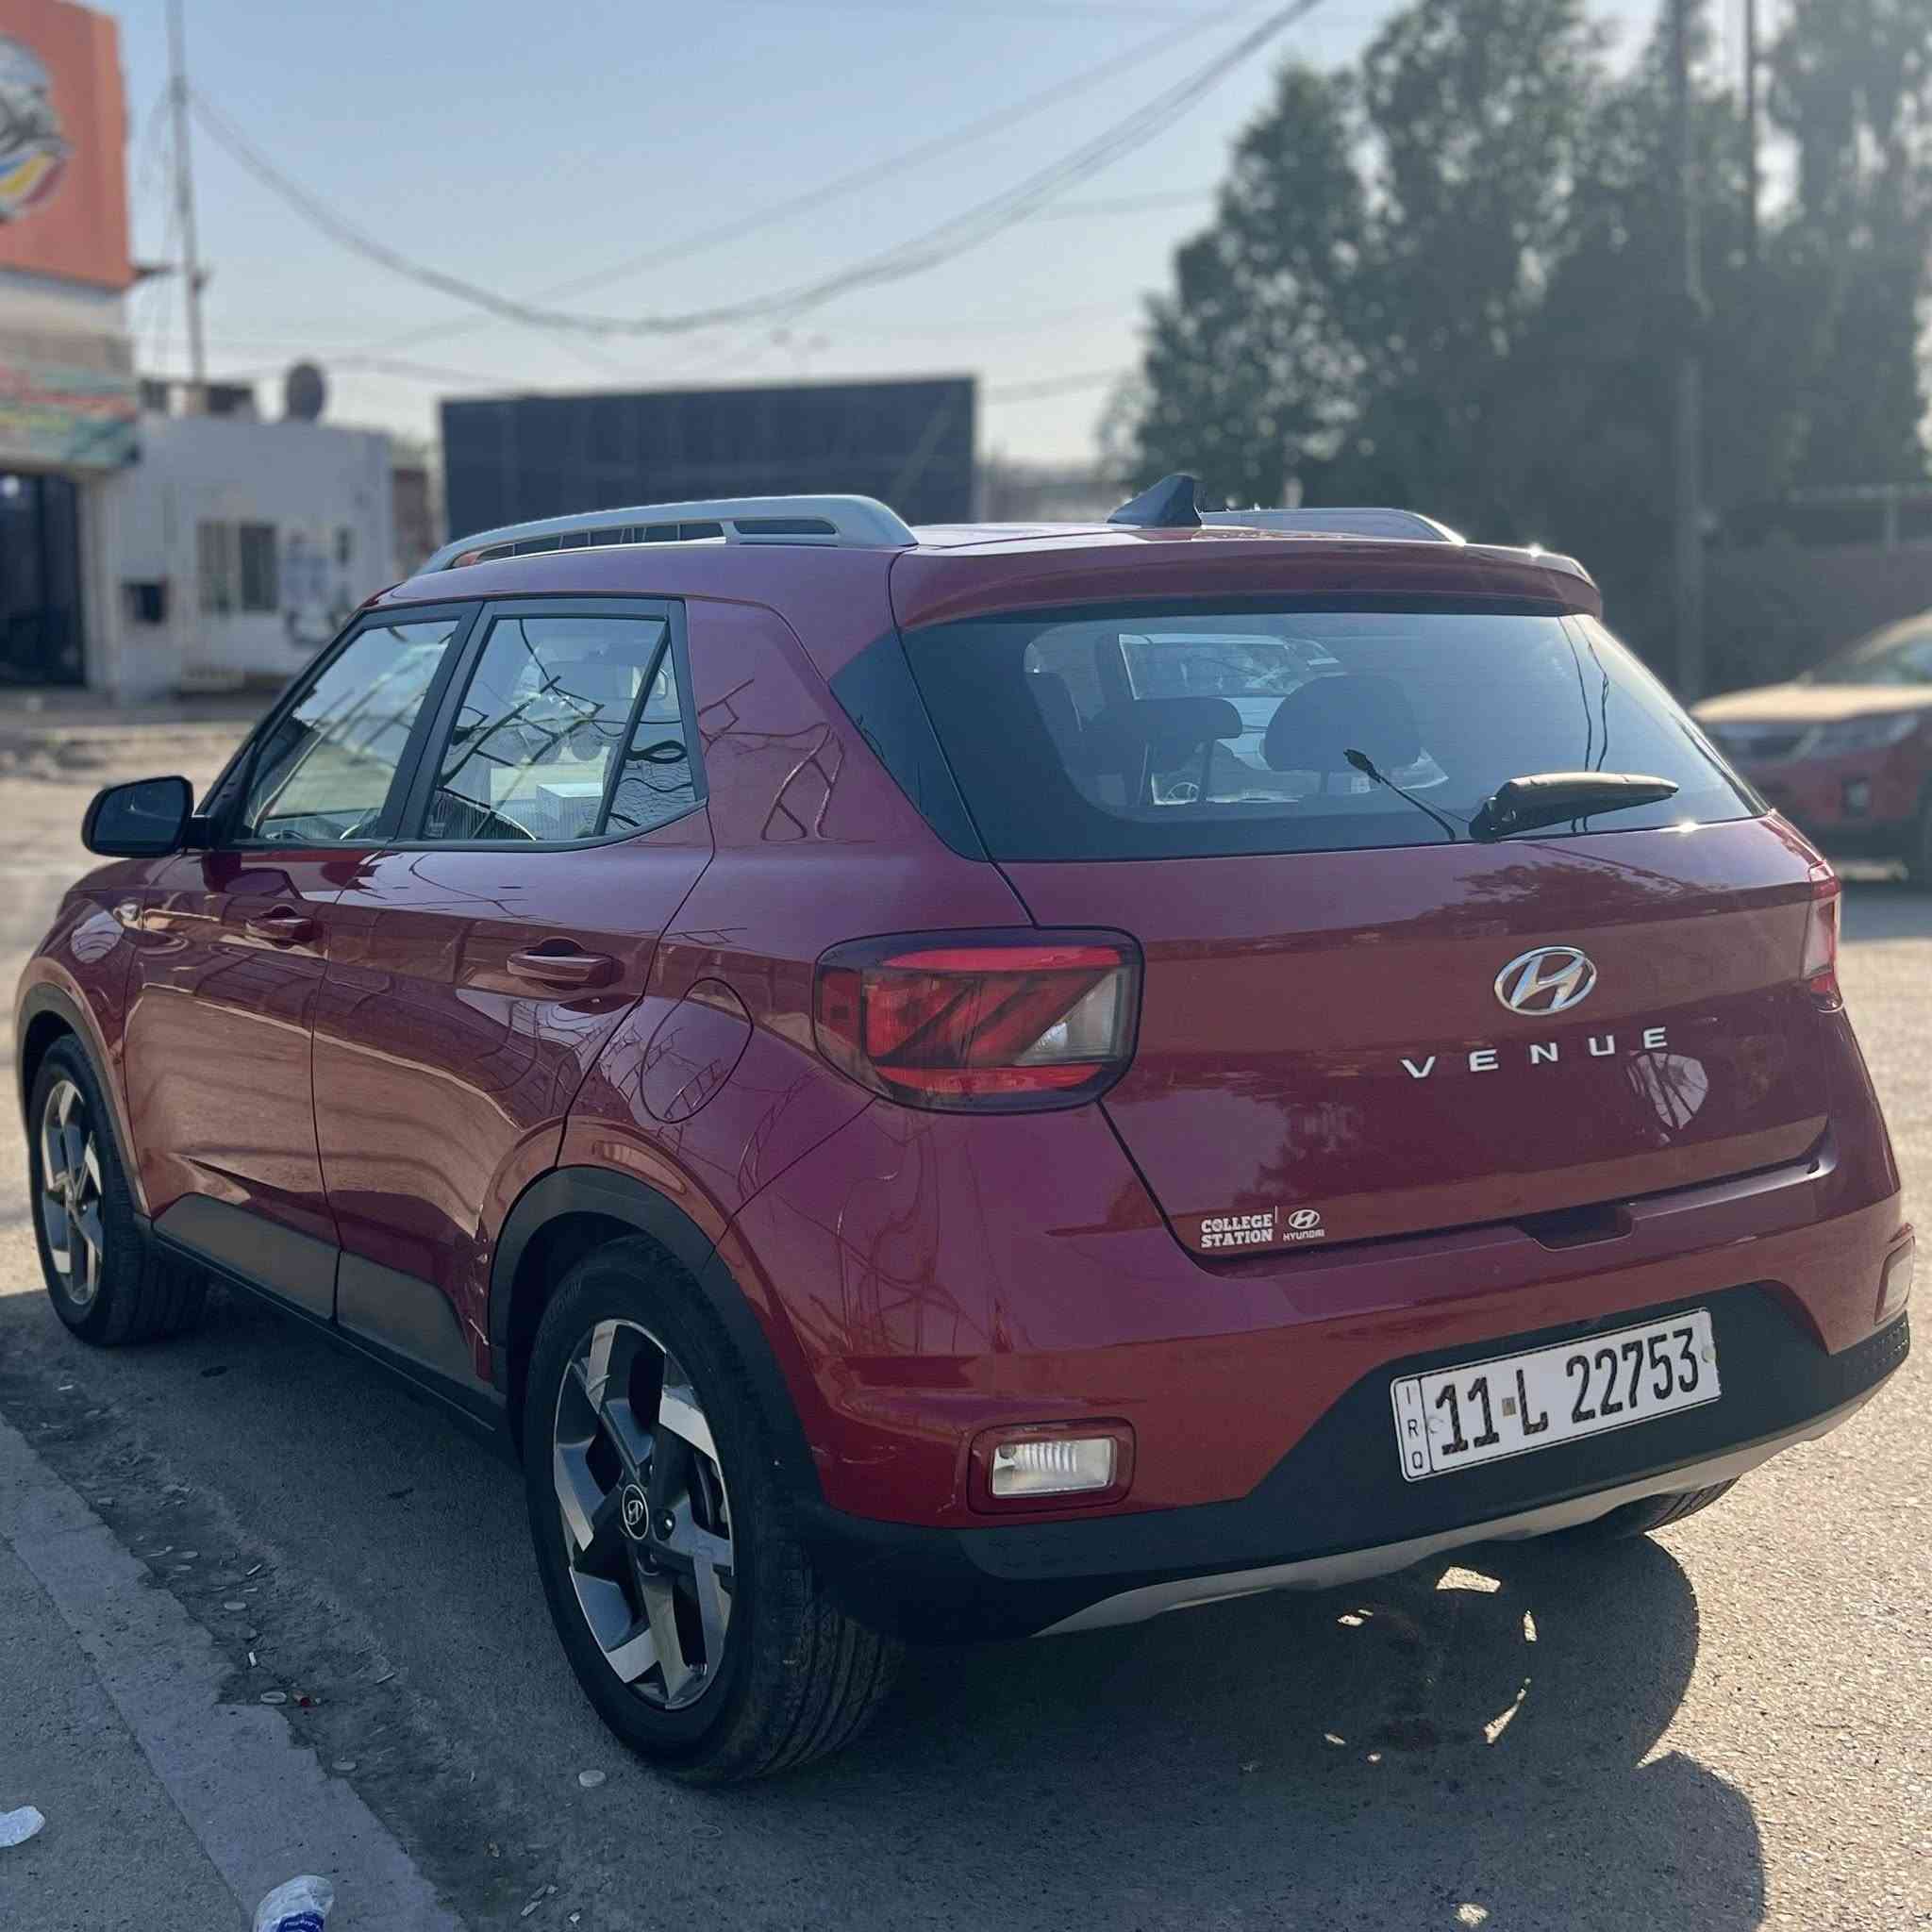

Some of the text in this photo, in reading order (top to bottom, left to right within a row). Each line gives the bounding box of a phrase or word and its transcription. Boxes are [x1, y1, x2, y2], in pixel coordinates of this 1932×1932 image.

[1400, 1026, 1668, 1079] VENUE
[1201, 1214, 1273, 1233] COLLEGE
[1201, 1229, 1273, 1248] STATION
[1283, 1229, 1325, 1242] HYUNDAI
[1436, 1327, 1698, 1456] 11 L 22753
